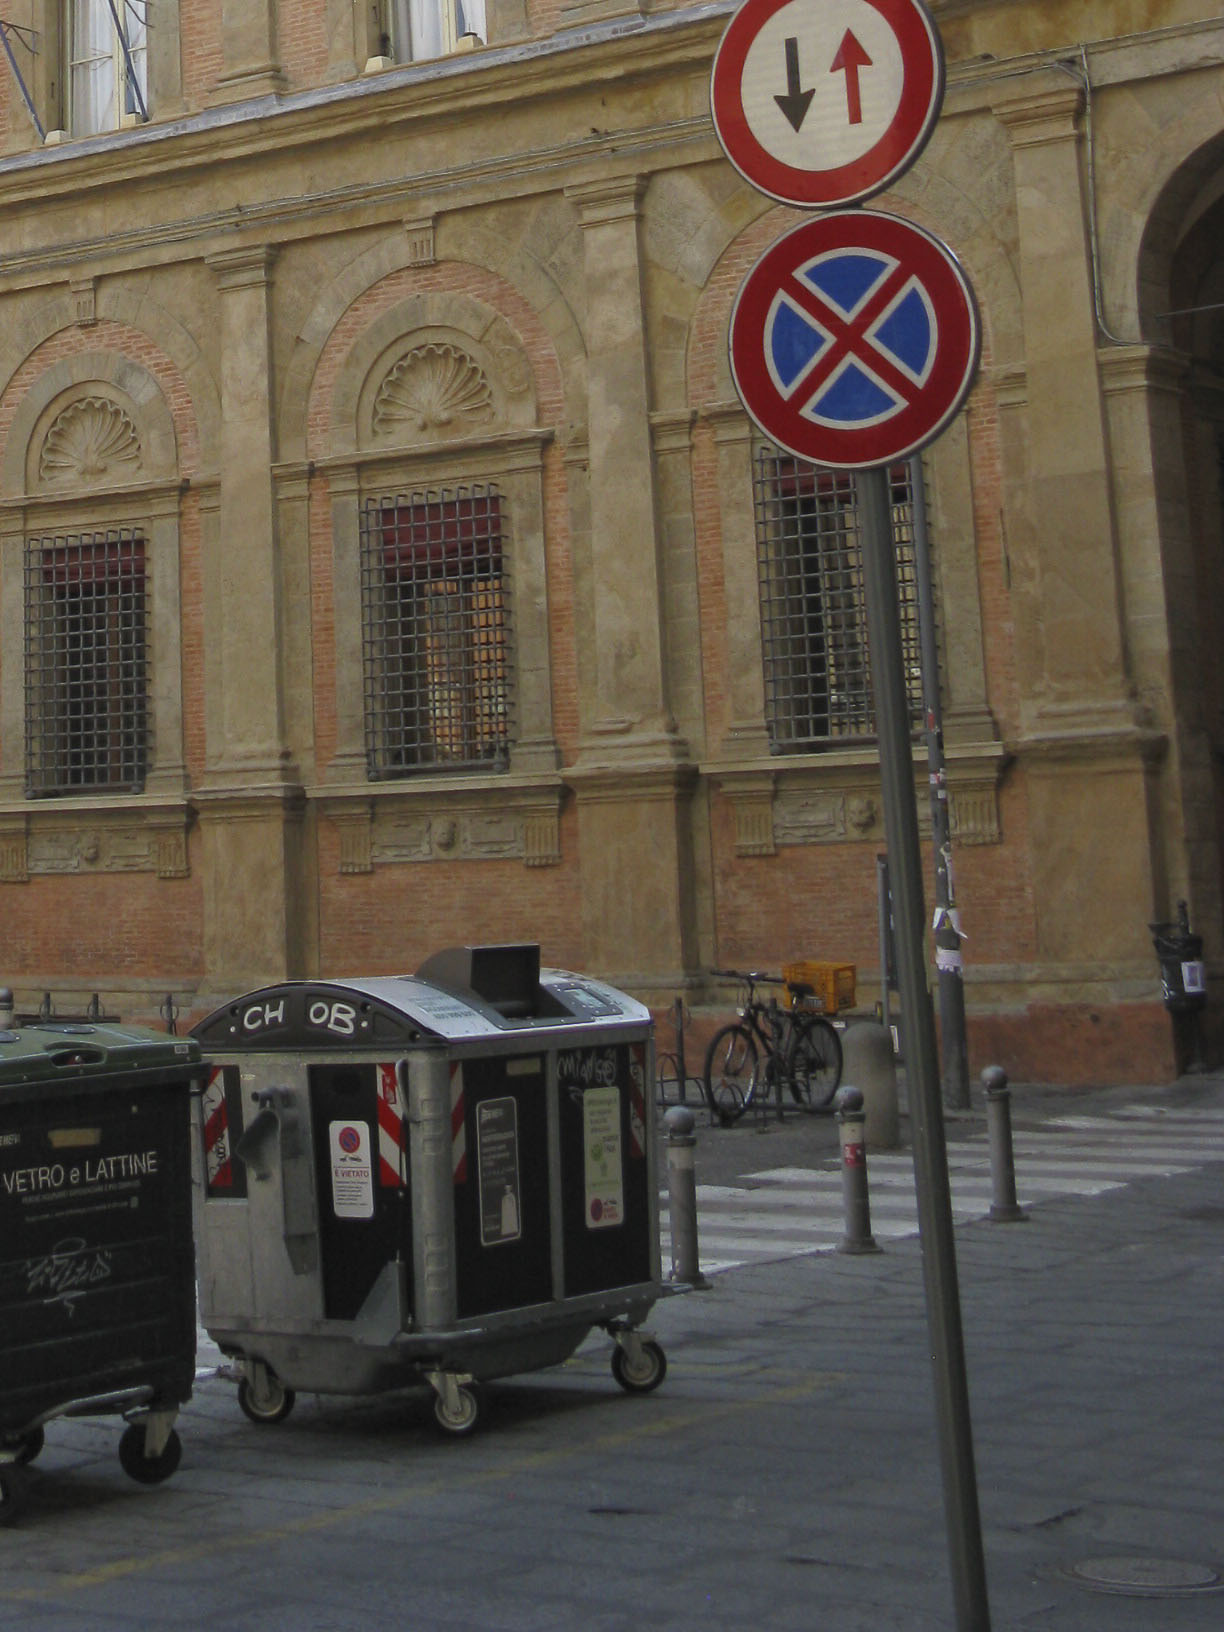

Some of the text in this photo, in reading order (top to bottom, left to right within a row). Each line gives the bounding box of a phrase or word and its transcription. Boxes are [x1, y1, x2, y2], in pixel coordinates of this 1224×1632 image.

[3, 1164, 65, 1195] VETRO
[69, 1167, 80, 1184] e
[85, 1151, 158, 1182] LATTINE
[341, 1170, 369, 1178] VIETATO
